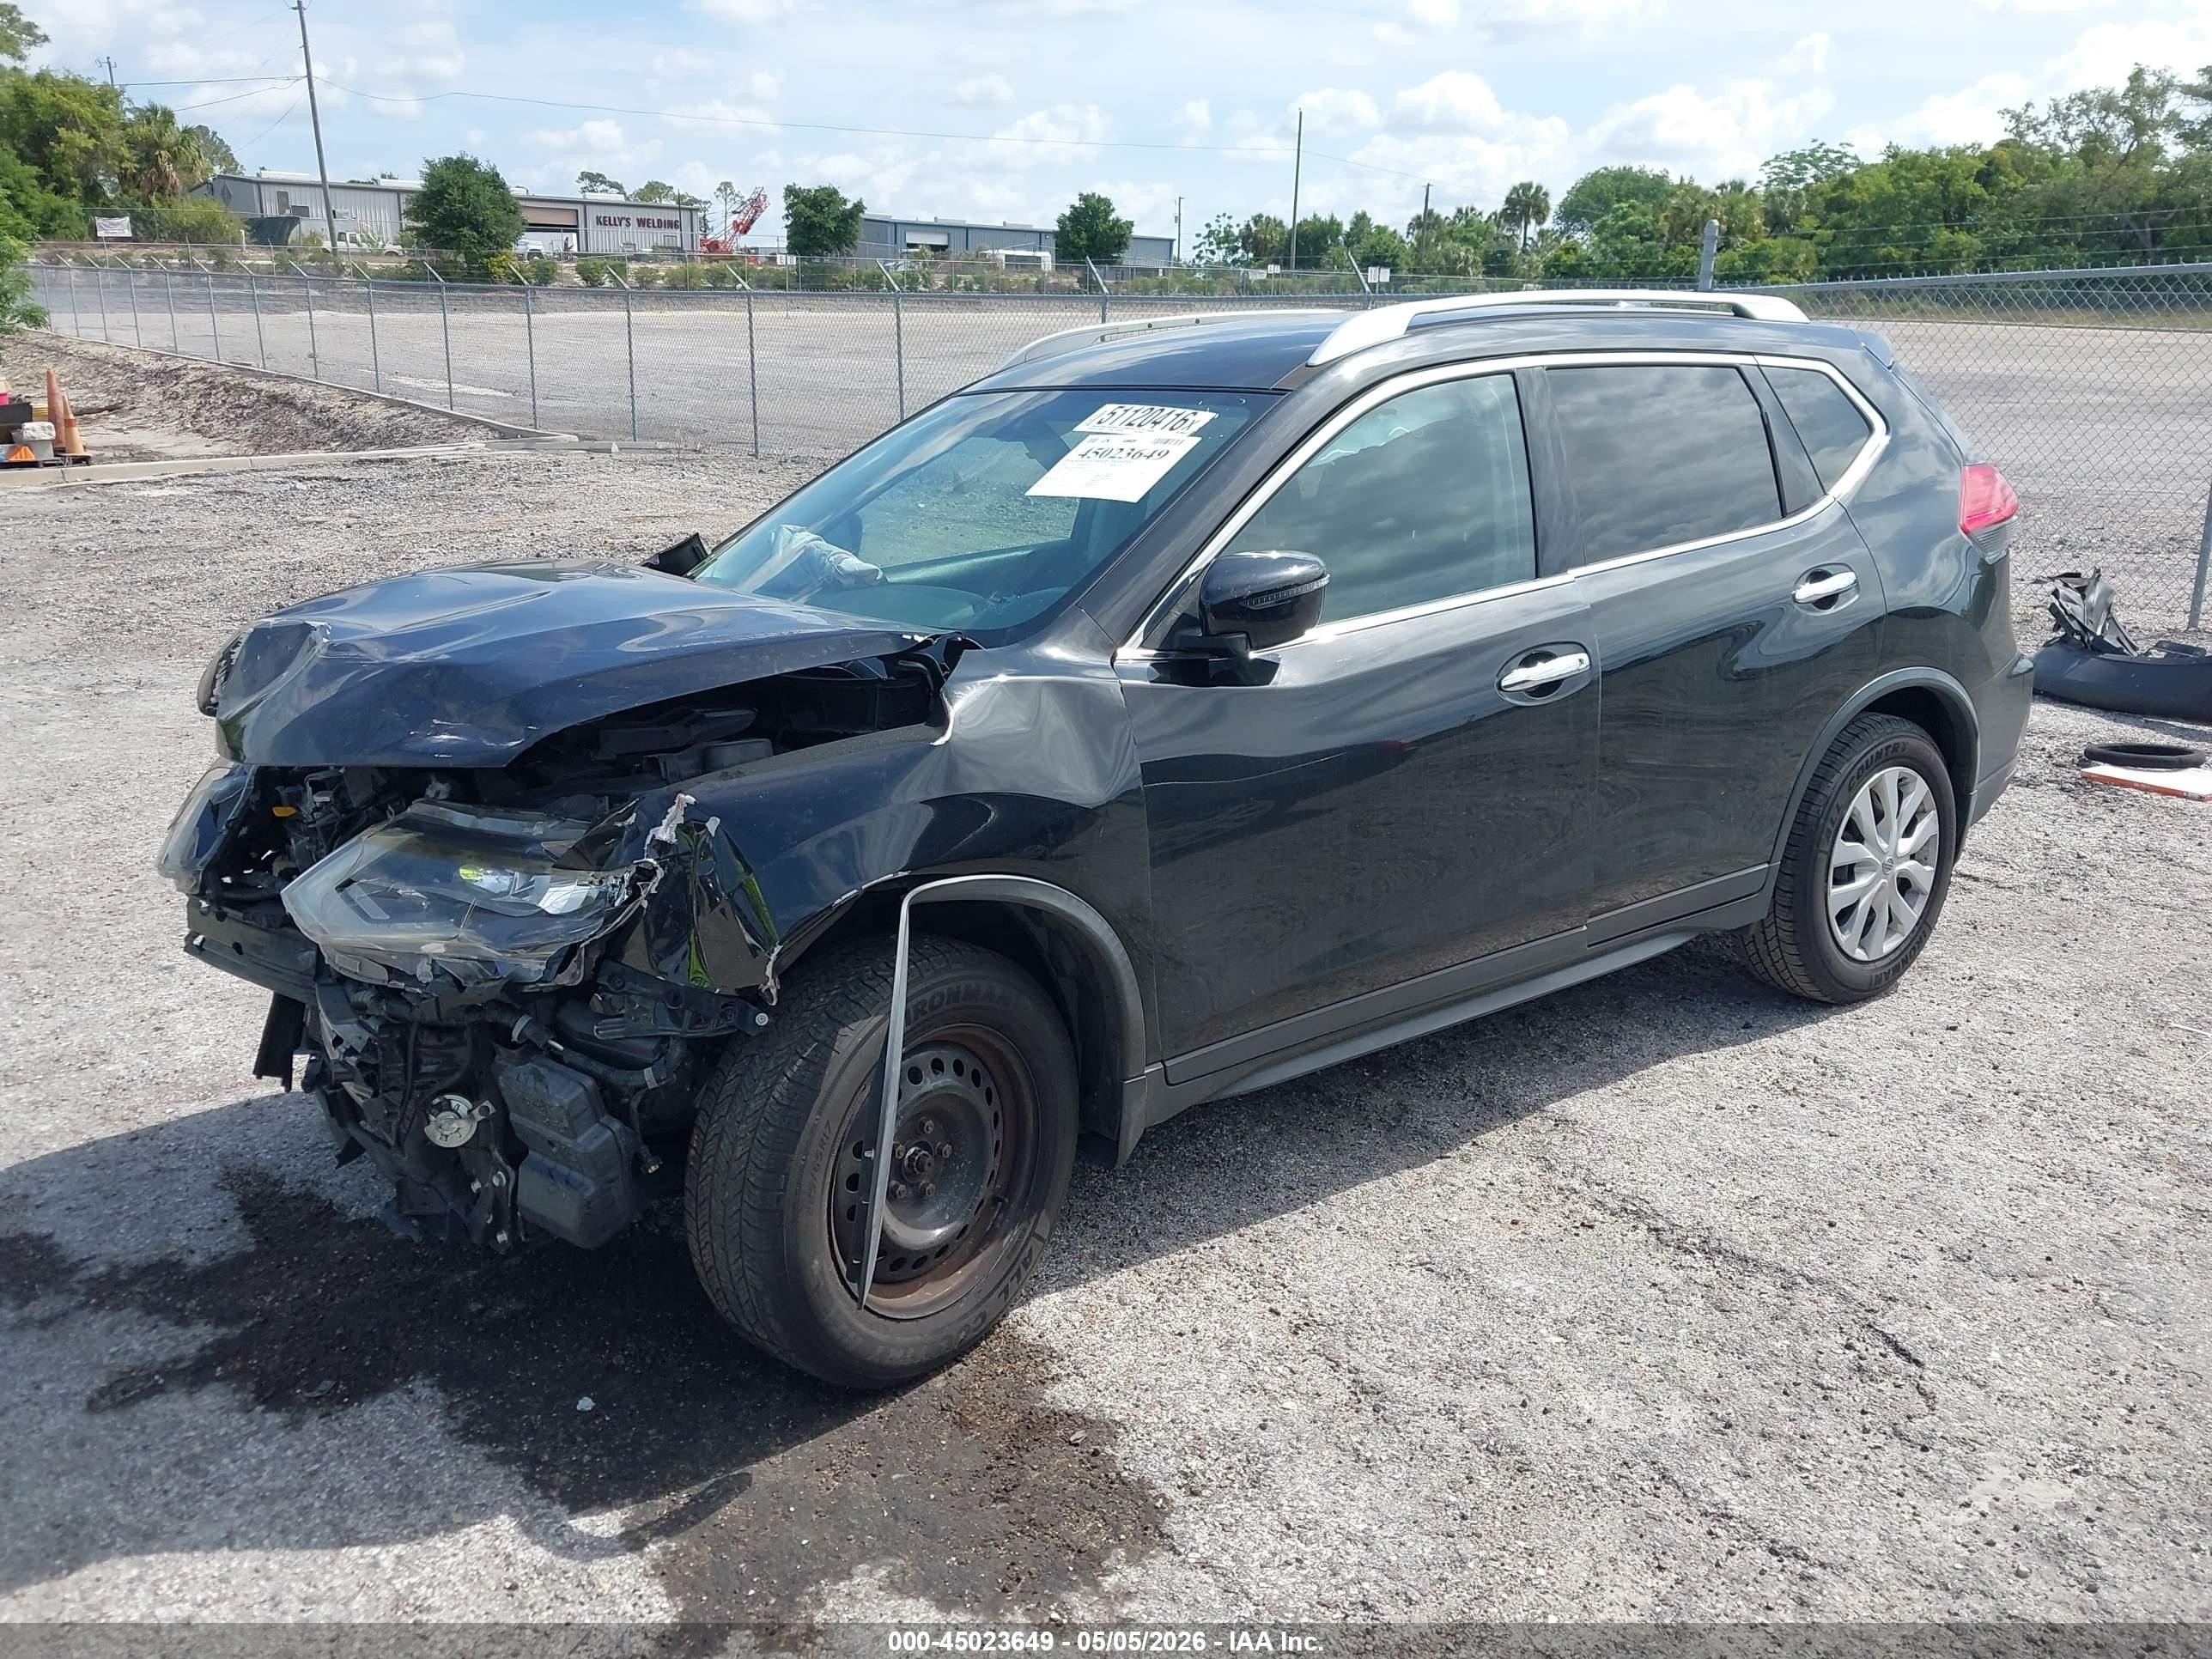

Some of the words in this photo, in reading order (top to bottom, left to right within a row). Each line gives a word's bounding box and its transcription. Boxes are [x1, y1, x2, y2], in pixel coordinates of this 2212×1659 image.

[596, 215, 631, 228] KELLY'S
[636, 217, 680, 229] WELDING
[1078, 447, 1170, 460] 45023649
[1847, 741, 1910, 793] COUNTRY
[1874, 928, 1928, 988] IRONMAN
[997, 1248, 1033, 1303] ALL
